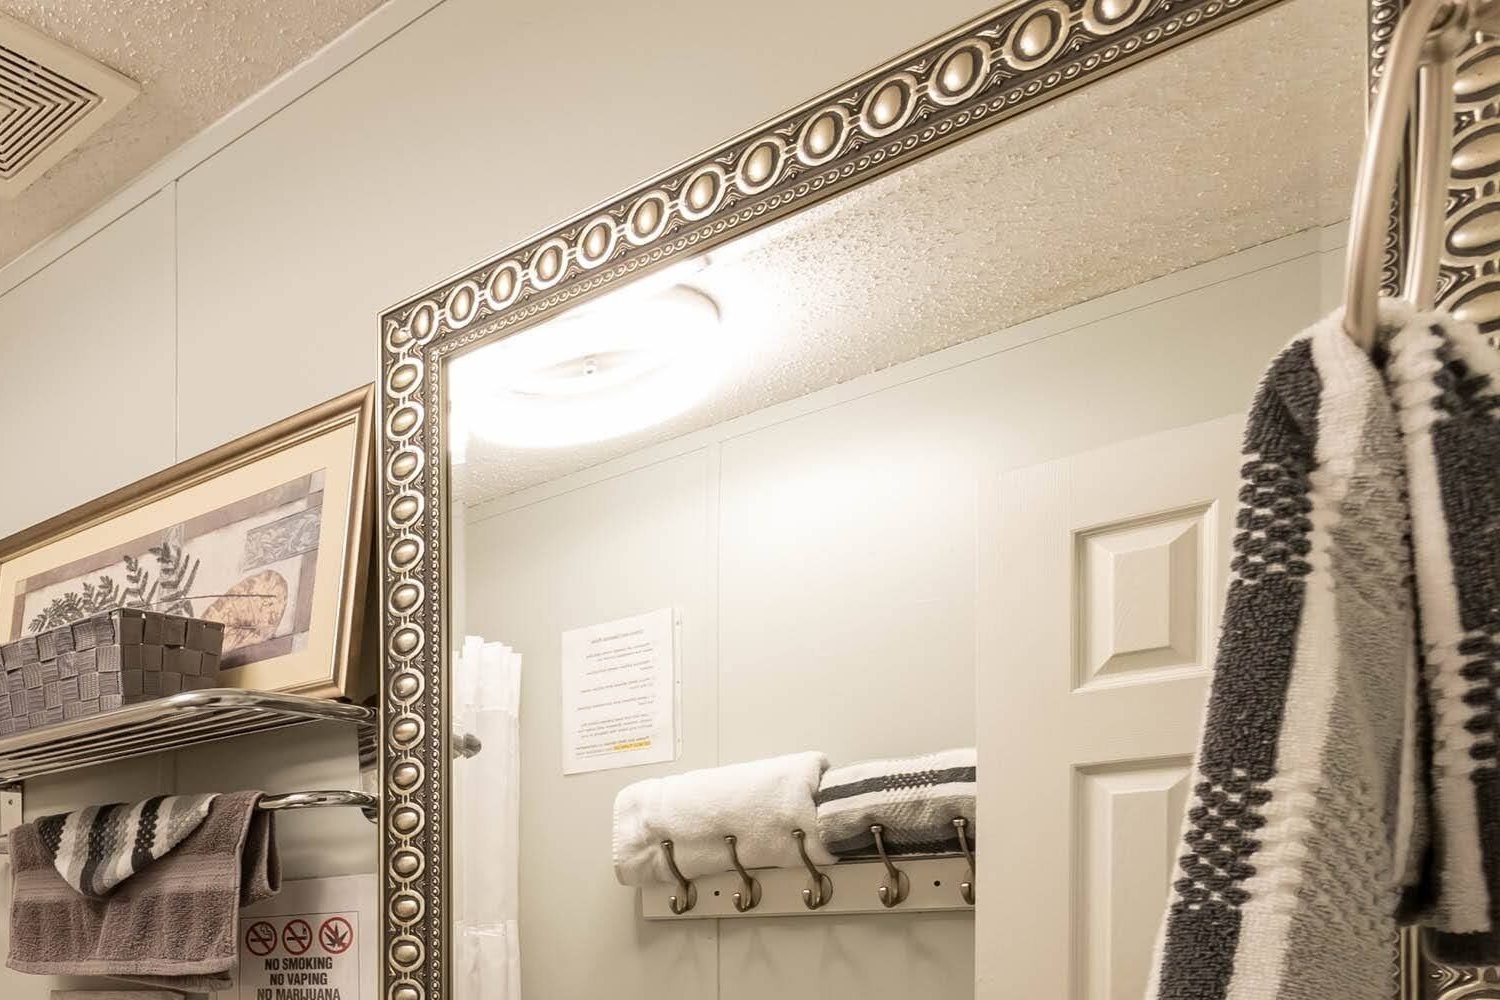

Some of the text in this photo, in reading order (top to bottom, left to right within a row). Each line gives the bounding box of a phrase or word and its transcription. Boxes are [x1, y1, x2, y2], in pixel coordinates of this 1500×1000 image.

[264, 957, 333, 970] NO SMOKING
[269, 972, 328, 986] NO VAPING
[256, 988, 341, 1000] NO MARIJUANA
